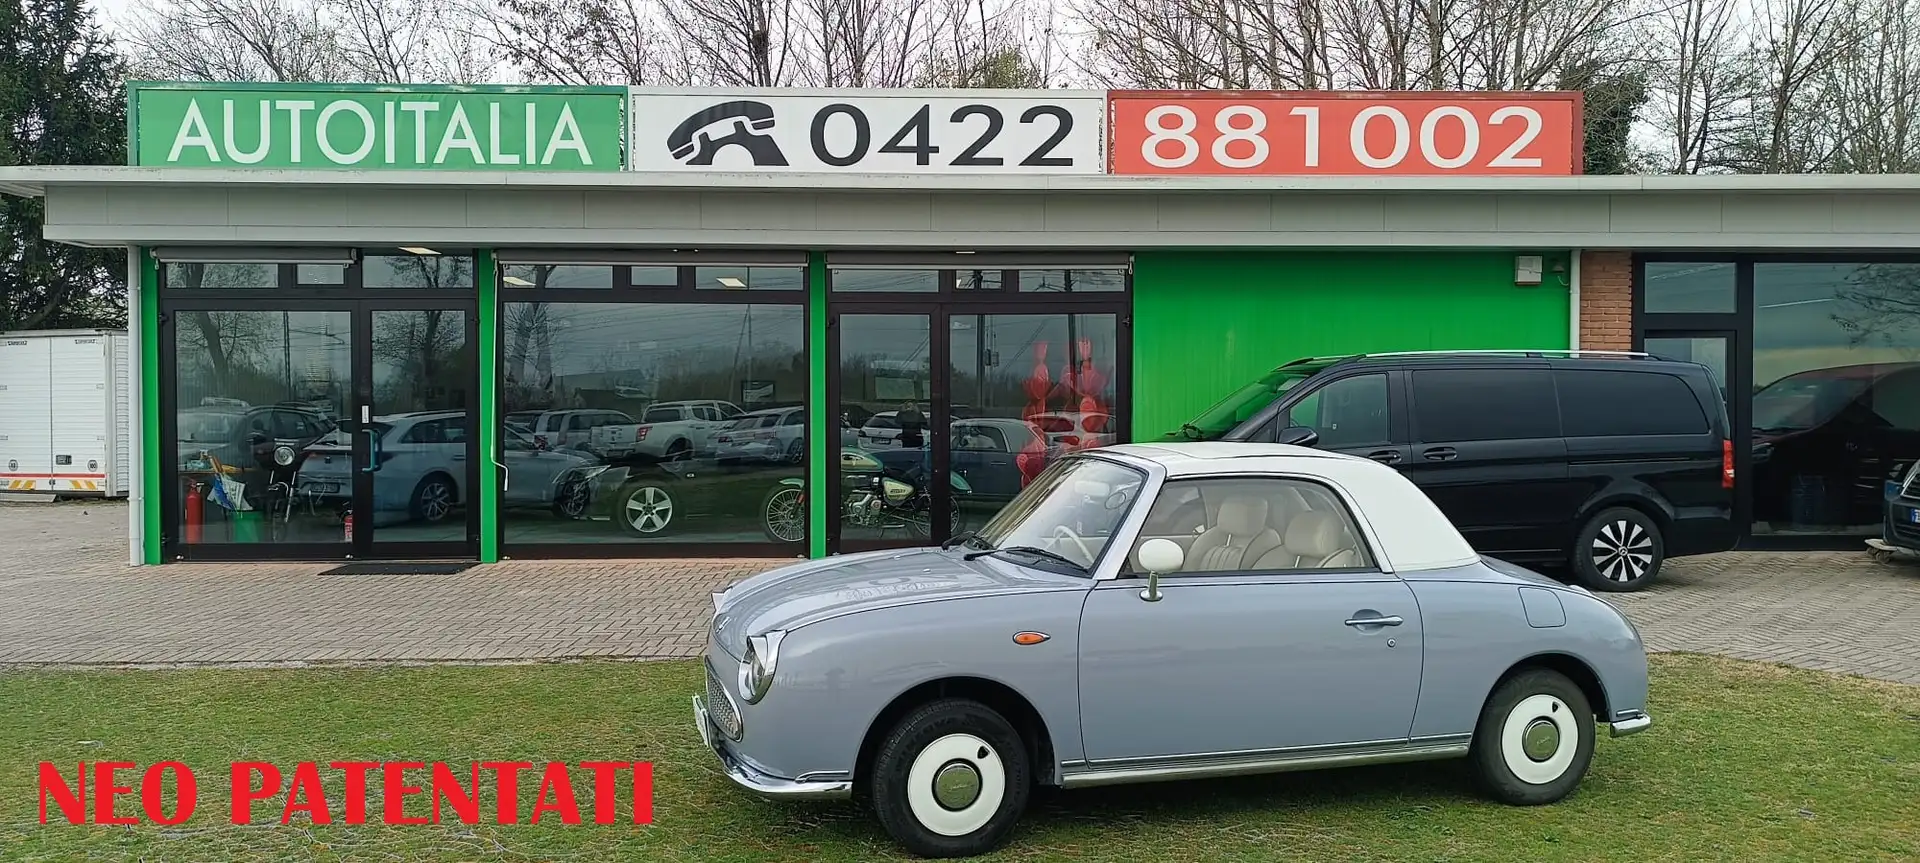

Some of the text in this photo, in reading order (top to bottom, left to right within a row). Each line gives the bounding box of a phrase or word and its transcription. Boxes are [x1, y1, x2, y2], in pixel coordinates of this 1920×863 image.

[167, 97, 594, 165] AUTOITALIA
[809, 103, 1074, 167] 0422
[1141, 105, 1544, 169] 881002
